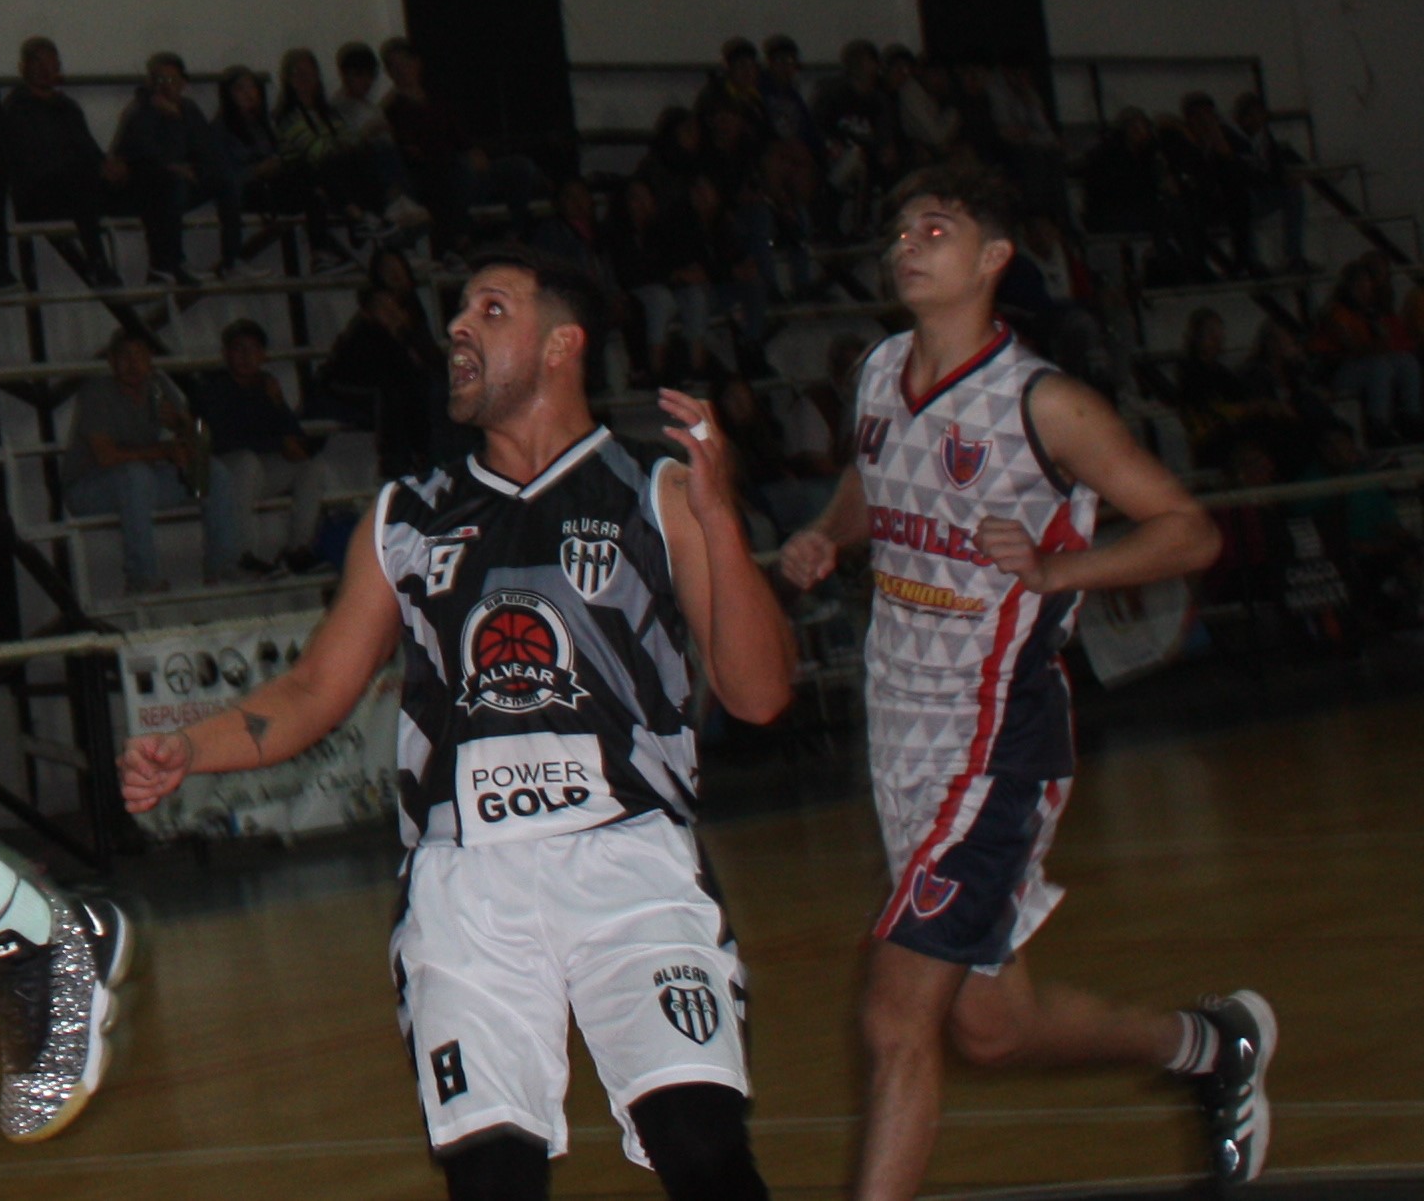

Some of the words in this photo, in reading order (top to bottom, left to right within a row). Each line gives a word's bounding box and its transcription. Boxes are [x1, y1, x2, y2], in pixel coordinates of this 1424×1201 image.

[561, 517, 621, 539] ALVEAR
[478, 662, 555, 689] ALVEAR
[471, 760, 590, 791] POWER
[476, 785, 590, 823] GOLD
[653, 964, 710, 987] ALVEAR
